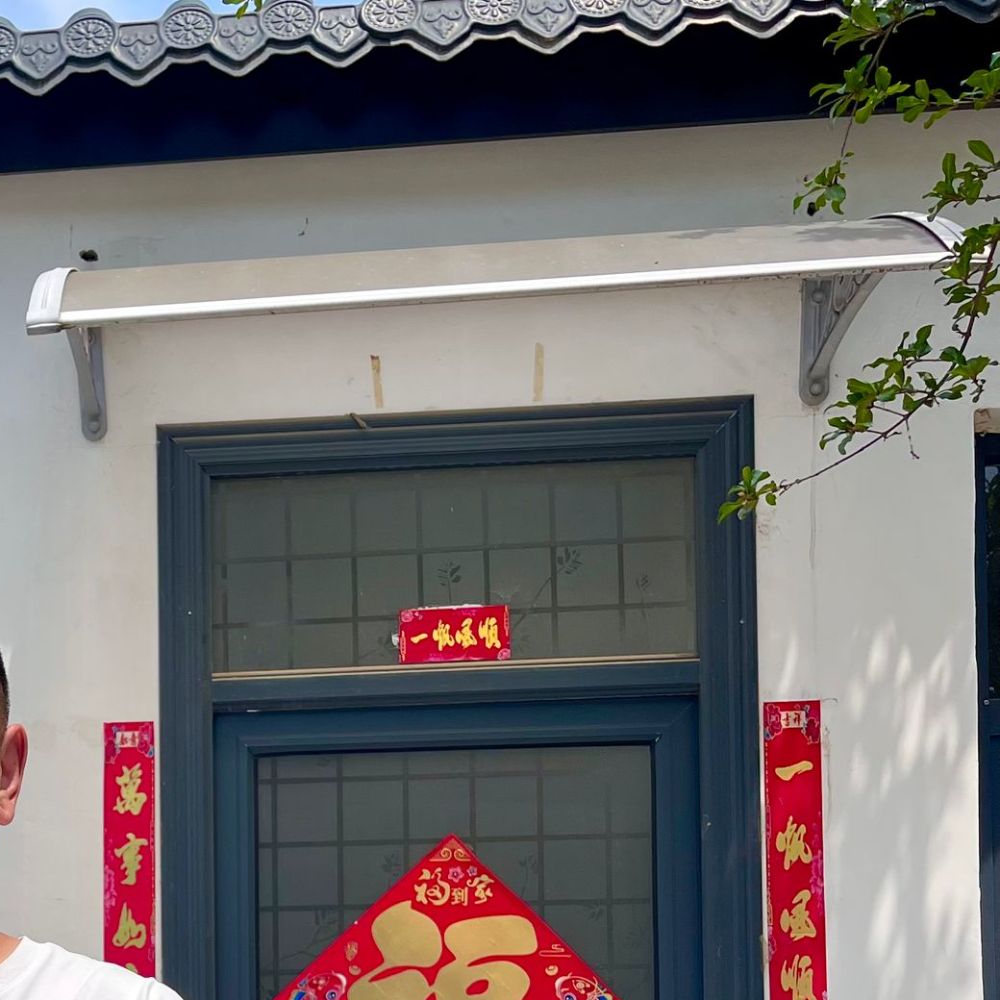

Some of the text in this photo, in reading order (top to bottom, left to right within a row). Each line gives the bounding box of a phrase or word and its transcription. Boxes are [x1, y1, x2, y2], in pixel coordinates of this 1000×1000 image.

[112, 764, 149, 974] 萬事如
[414, 867, 495, 907] 福到家
